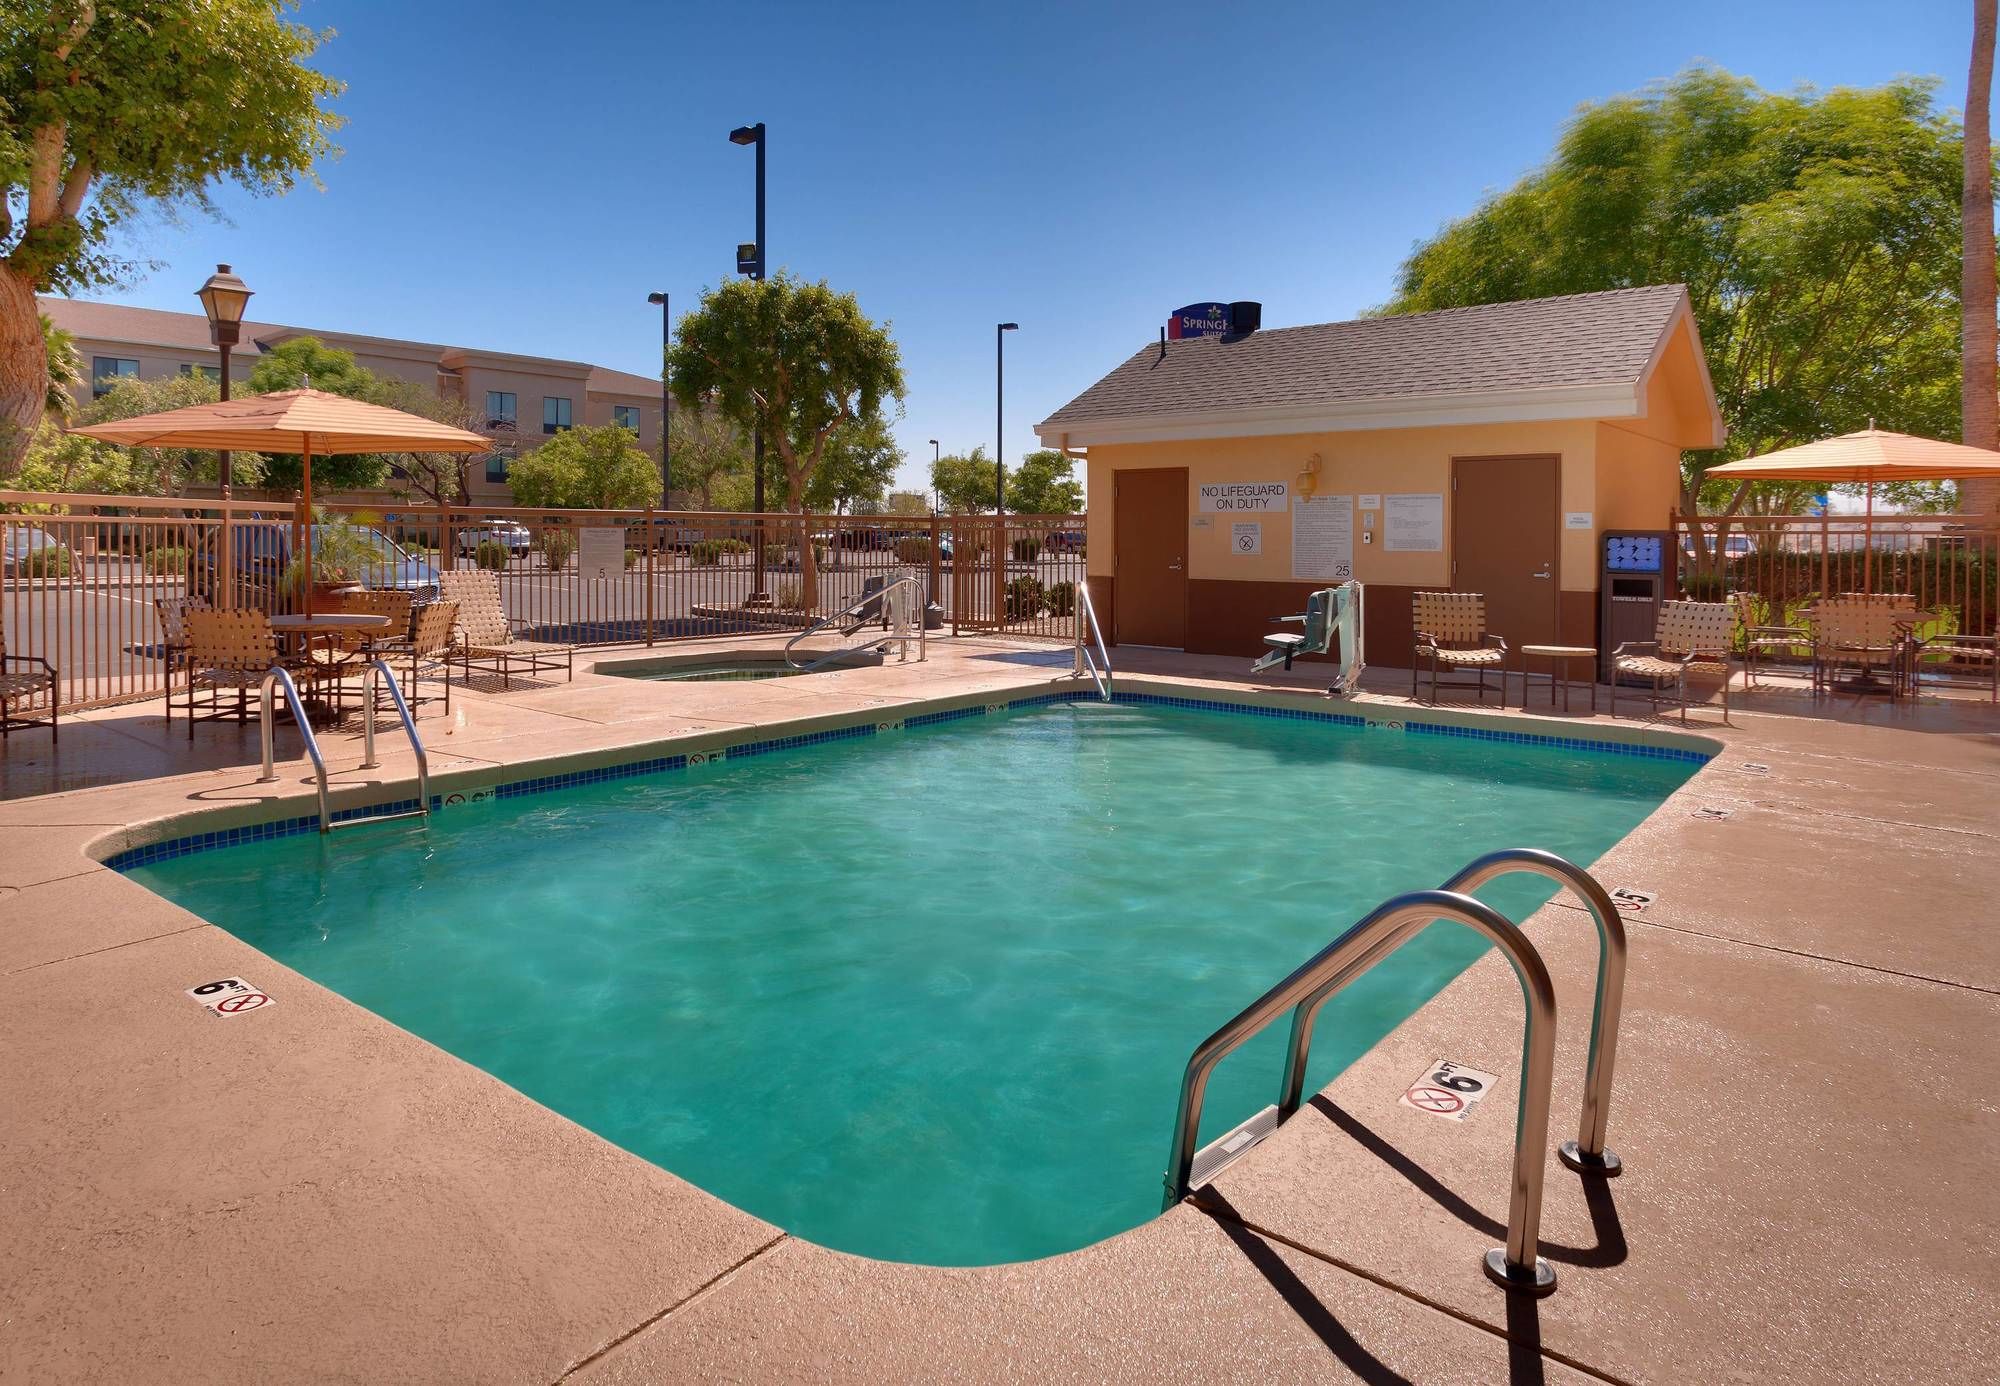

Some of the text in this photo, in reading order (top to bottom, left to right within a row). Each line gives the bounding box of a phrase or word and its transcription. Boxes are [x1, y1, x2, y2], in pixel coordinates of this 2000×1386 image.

[1201, 484, 1285, 497] NO LIFEGUARD
[1216, 498, 1269, 510] ON DUTY
[599, 568, 606, 579] 5
[1335, 565, 1350, 577] 25
[1614, 891, 1651, 903] 5
[193, 979, 239, 995] 6
[1431, 1071, 1483, 1093] 6
